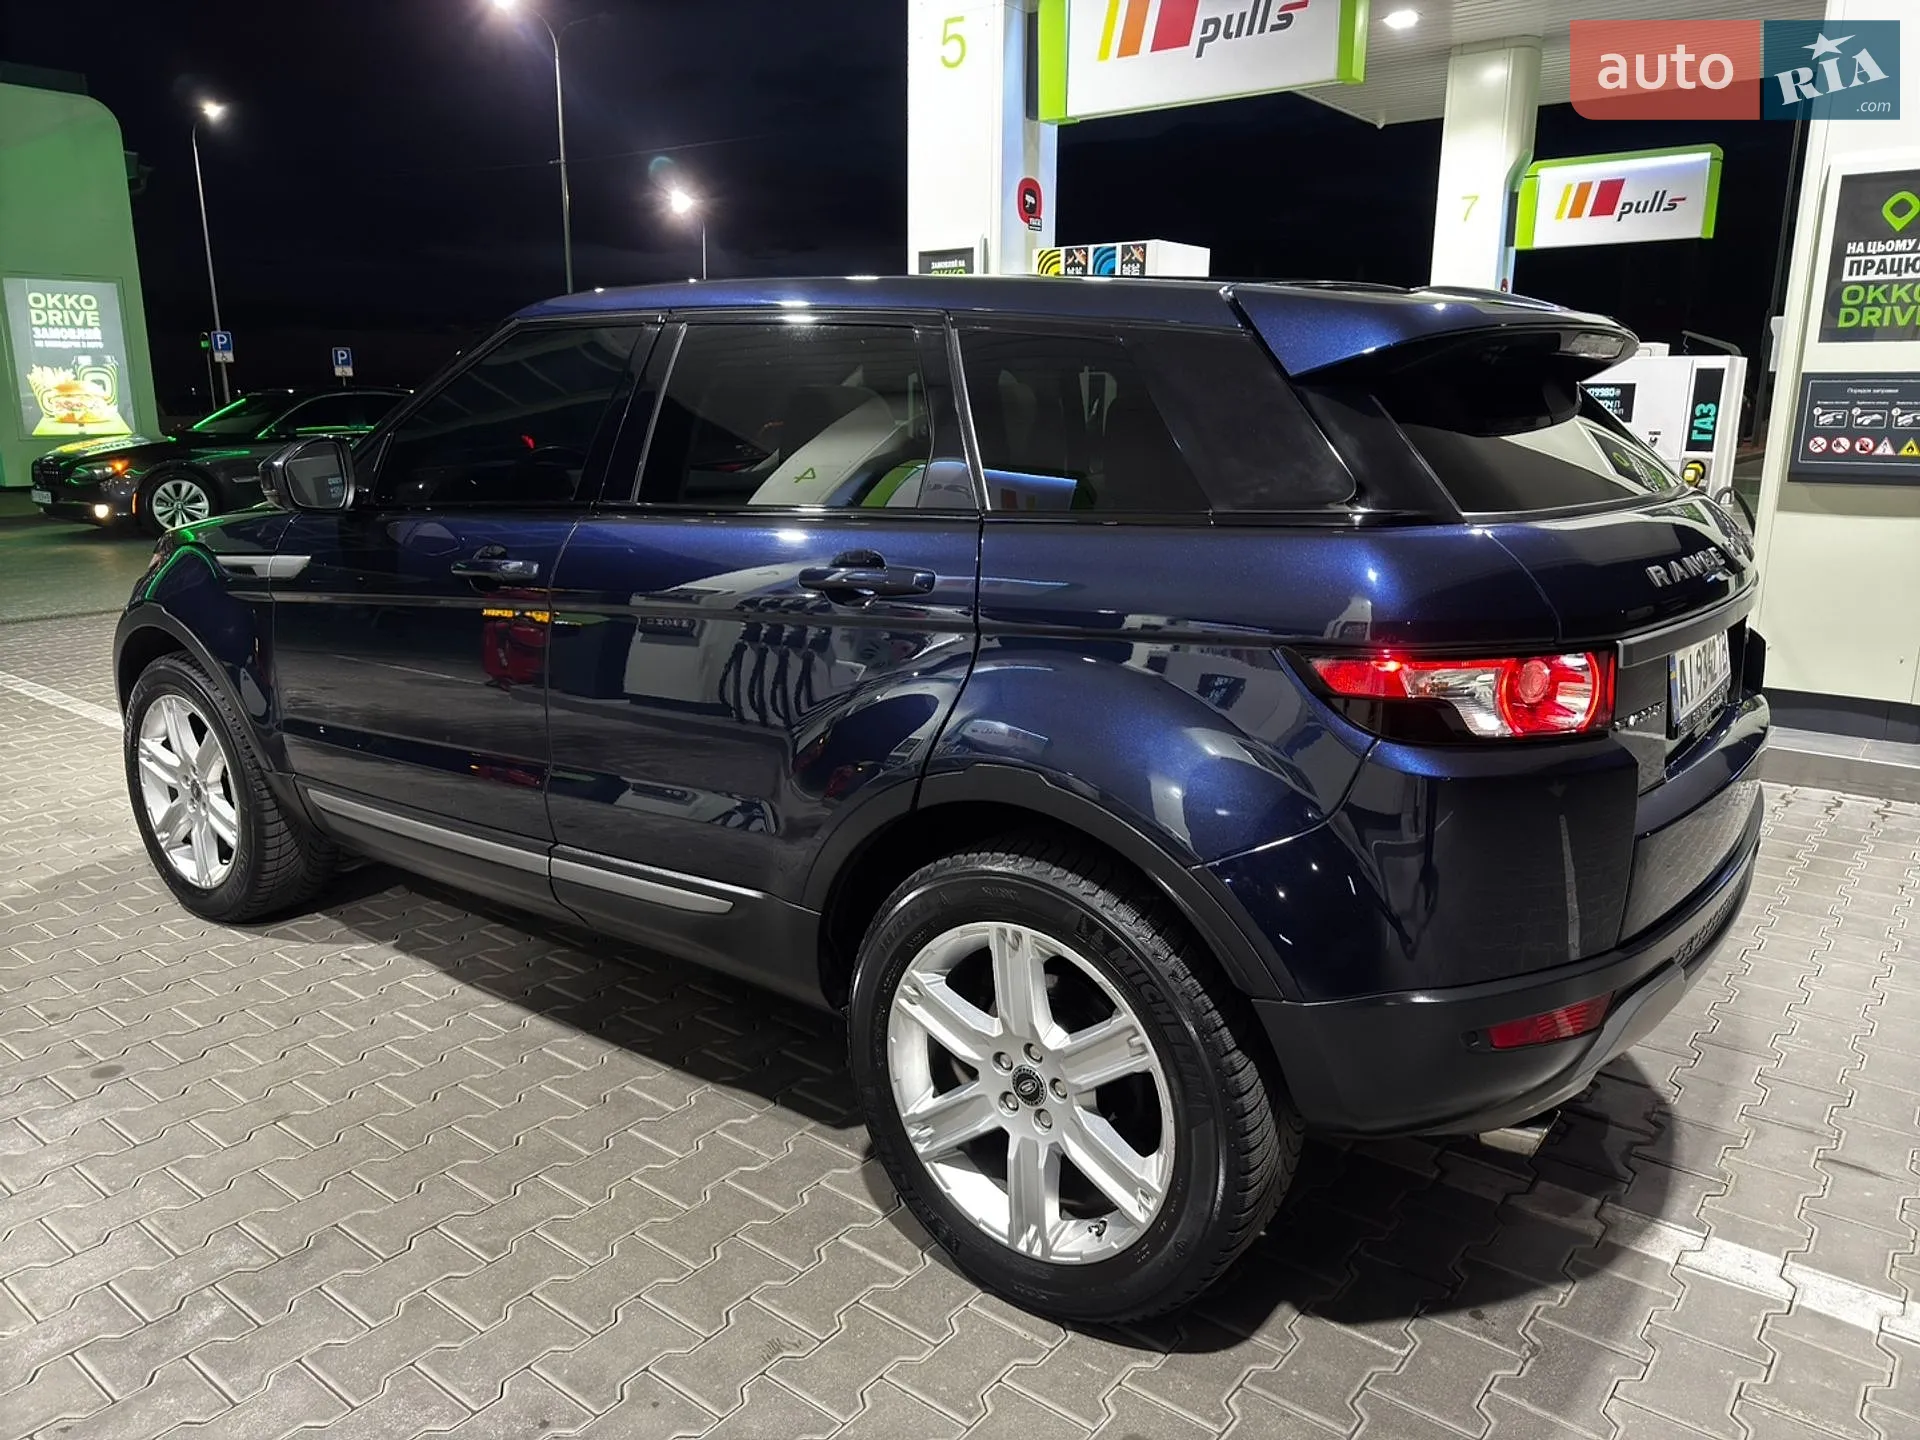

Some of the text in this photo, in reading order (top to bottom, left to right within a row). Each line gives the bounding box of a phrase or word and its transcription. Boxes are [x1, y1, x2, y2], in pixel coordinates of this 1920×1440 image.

[940, 15, 968, 69] 5
[1196, 0, 1304, 58] pulls
[1461, 195, 1479, 222] 7
[1616, 189, 1684, 222] pulls
[1846, 241, 1864, 255] НА
[1866, 238, 1917, 256] ЦЬОМУ
[28, 292, 97, 310] OKKO
[30, 309, 101, 326] DRIVE
[216, 334, 228, 350] P
[337, 350, 348, 365] P
[1691, 402, 1718, 442] ГАЗ
[1645, 546, 1726, 588] RANGE
